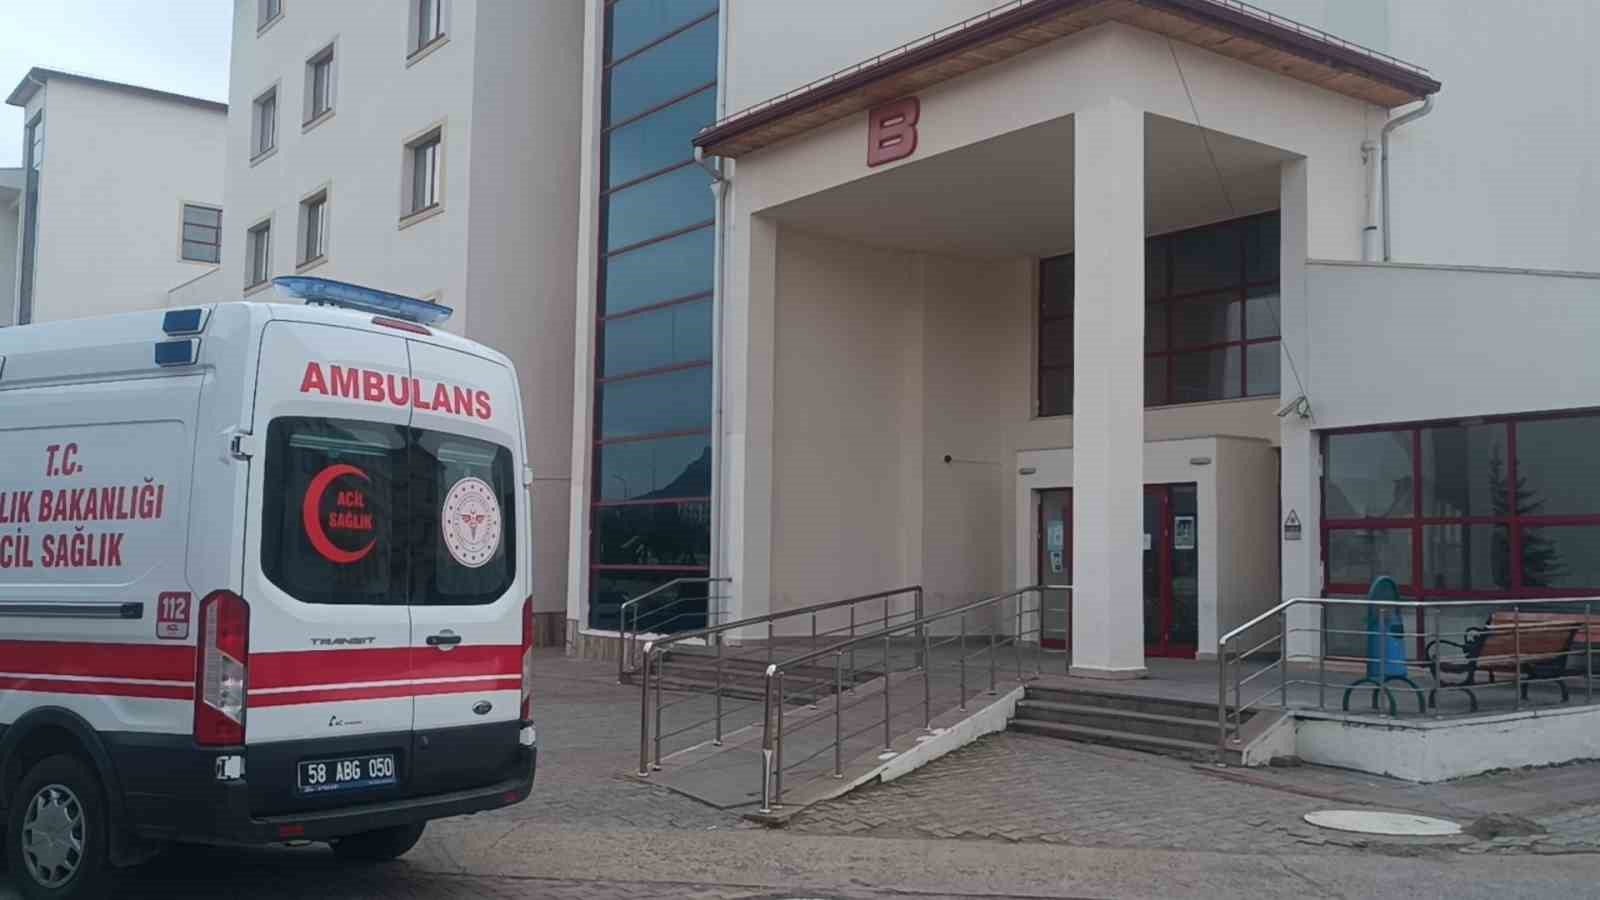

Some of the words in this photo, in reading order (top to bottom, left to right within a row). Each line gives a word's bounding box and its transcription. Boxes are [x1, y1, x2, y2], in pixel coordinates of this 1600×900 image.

[867, 96, 920, 168] B
[300, 361, 492, 420] AMBULANS
[46, 442, 83, 477] T.C.
[38, 476, 165, 522] BAKANLIĞI
[41, 525, 125, 568] SAĞLIK
[162, 598, 186, 619] 112
[310, 636, 376, 646] TRANSIT
[308, 764, 327, 784] 58
[336, 760, 361, 781] ABG
[368, 757, 393, 778] 050
